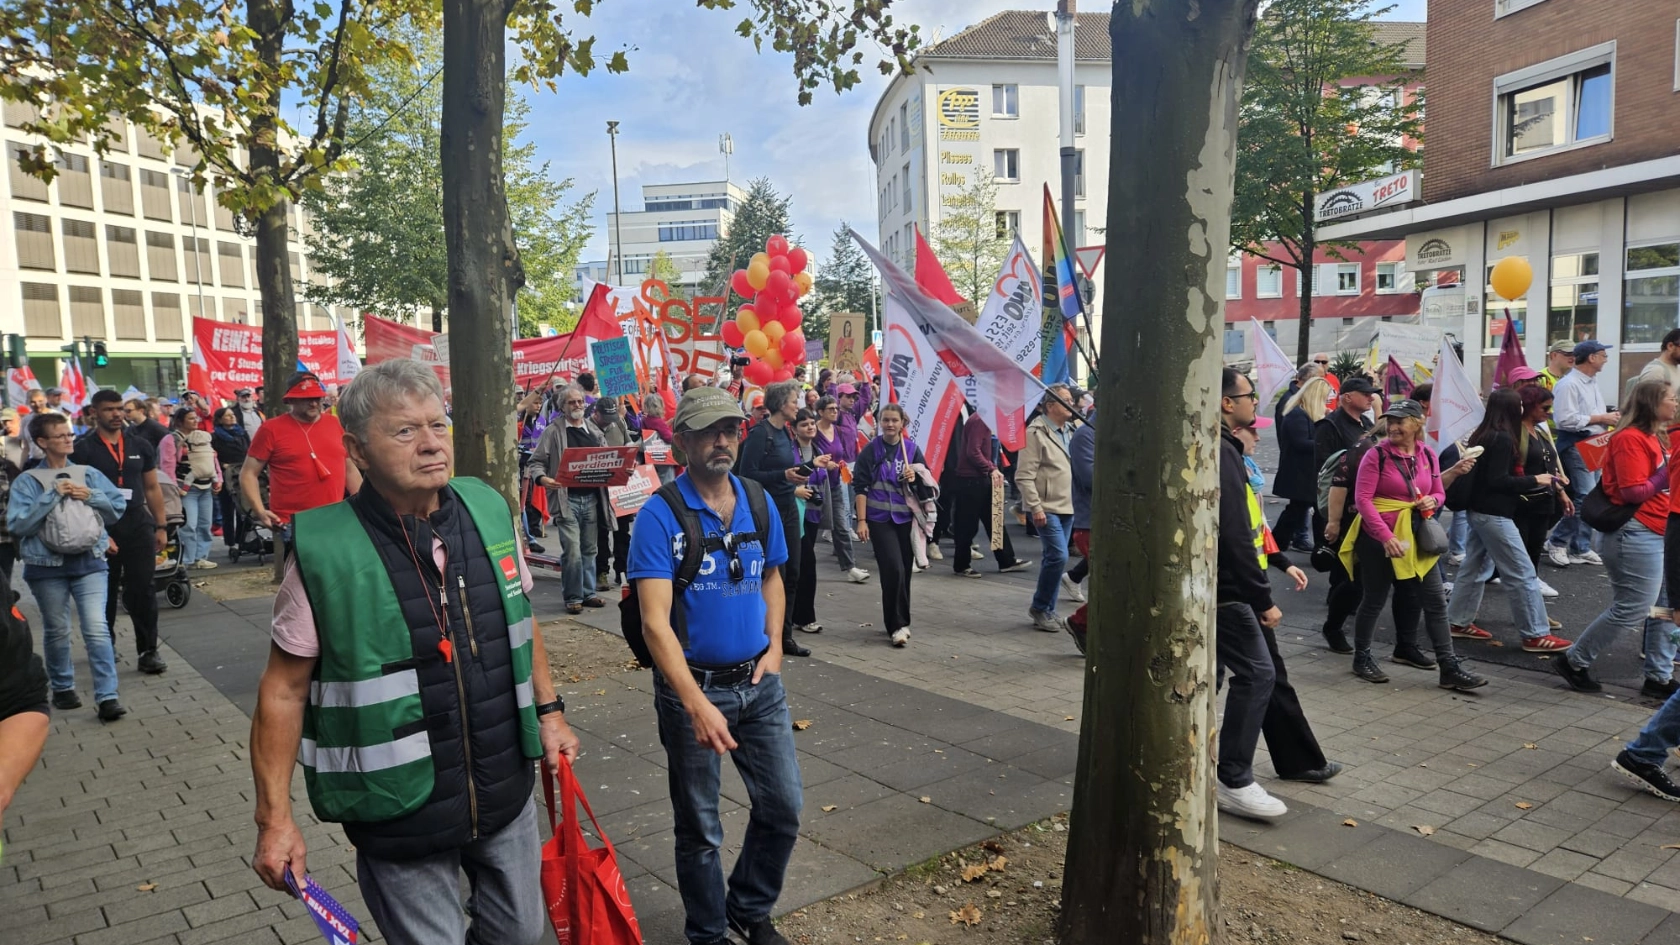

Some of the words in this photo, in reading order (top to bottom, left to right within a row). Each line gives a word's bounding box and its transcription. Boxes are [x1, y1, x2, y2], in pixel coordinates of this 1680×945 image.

[941, 172, 966, 185] Rollos
[1372, 175, 1408, 203] TRETO
[1319, 201, 1363, 218] TRETOBRATZE
[212, 327, 250, 353] KEINE
[229, 356, 236, 369] 7
[237, 357, 263, 370] Stund
[210, 371, 226, 384] per
[227, 370, 260, 383] Gesetz
[590, 452, 616, 461] Hart
[571, 459, 623, 470] verdient!
